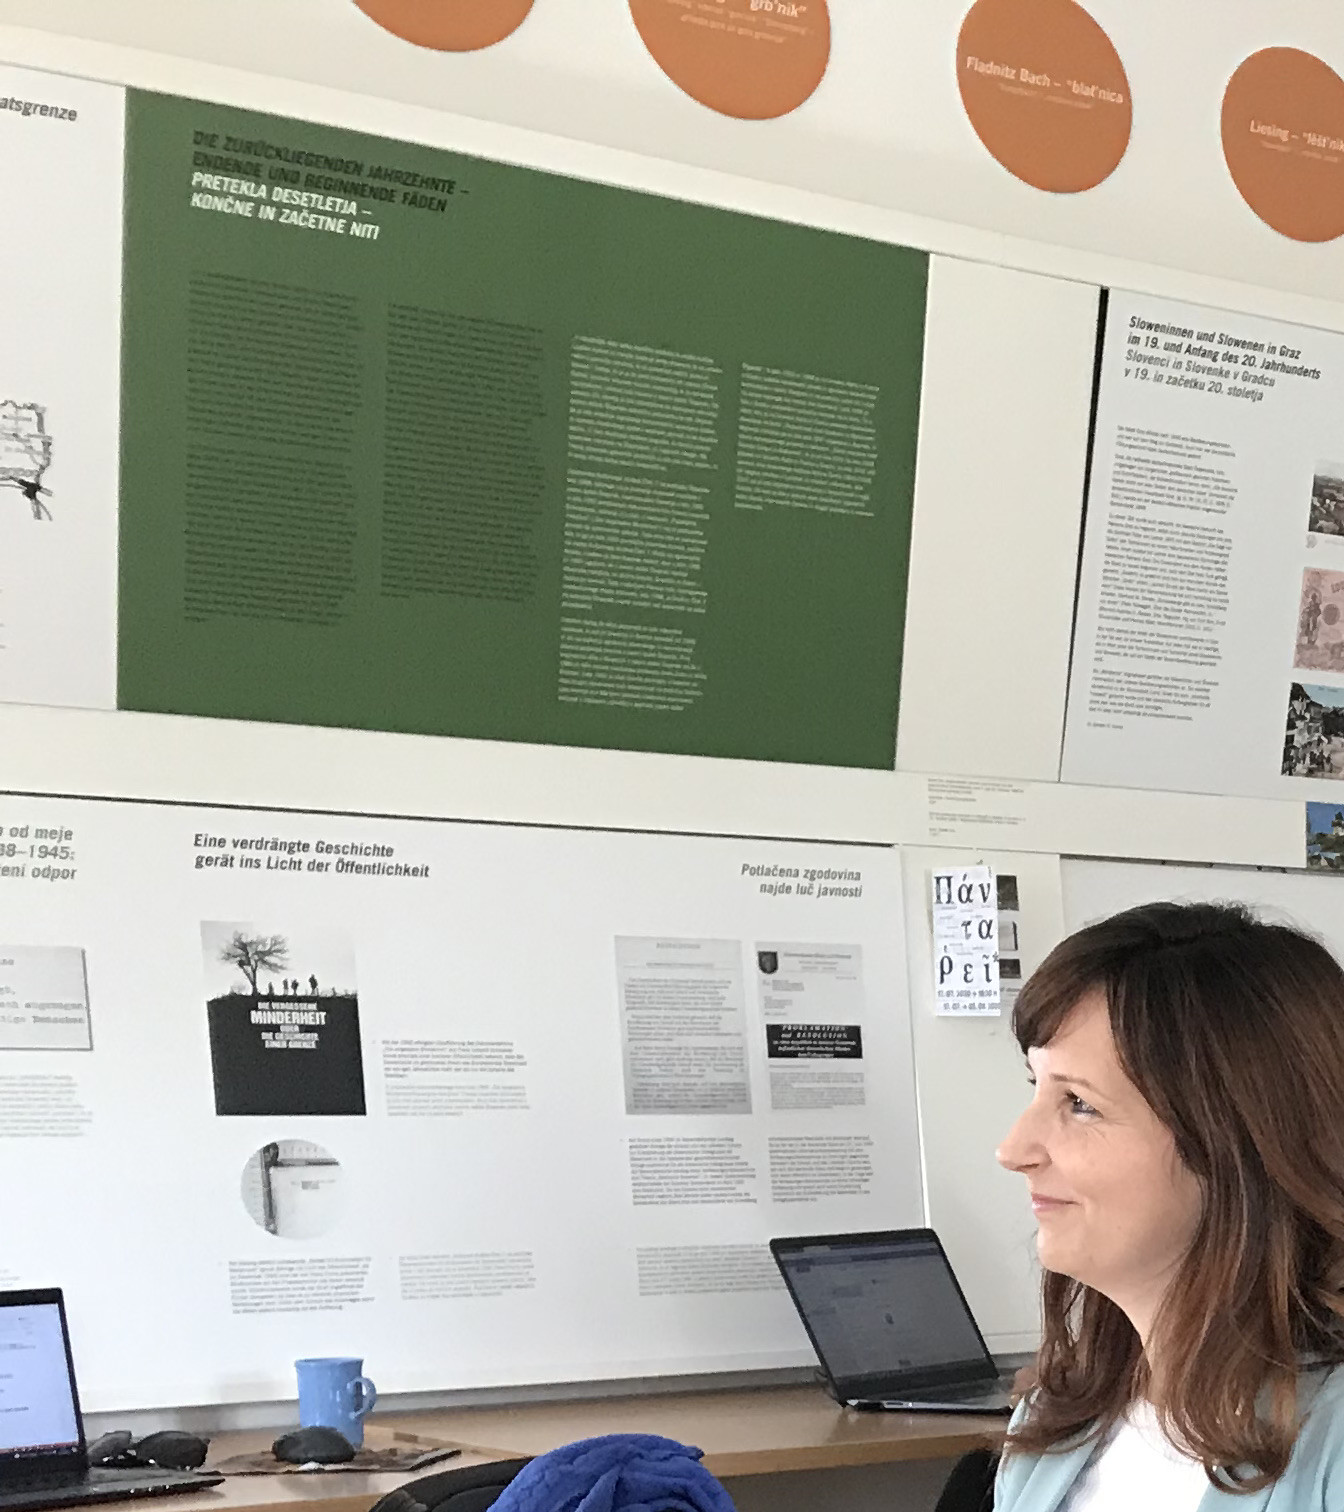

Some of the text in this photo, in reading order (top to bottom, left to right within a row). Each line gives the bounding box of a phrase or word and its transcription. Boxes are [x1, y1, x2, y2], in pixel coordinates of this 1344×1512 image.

[966, 56, 1050, 87] Fladnitz Bach
[193, 152, 262, 178] ENDENDE
[269, 165, 299, 184] UND
[304, 173, 396, 203] BEGINNENDE
[194, 130, 216, 146] DIE
[367, 165, 457, 195] JAHRZEHNTE
[192, 172, 357, 216] PRETEKLA DESETLETJA
[191, 192, 380, 240] KONČNE IN ZAČETNE NITI
[1129, 315, 1301, 360] Sloweninnen und Slowenen in Graz
[1125, 349, 1276, 387] Slovenci in Slovenke v Gradcu
[1127, 332, 1321, 380] im 19. und Anfang des 20. Jahrhunderts
[1124, 367, 1264, 402] v 19. in začetku 20. stoletja
[9, 825, 73, 843] od meje
[193, 833, 394, 858] Eine verdrängte Geschichte
[32, 865, 77, 881] odpor
[195, 854, 430, 878] gerät ins Licht der Öffentlichkeit
[741, 863, 862, 881] Potlačena zgodovina
[760, 882, 862, 898] najde luč javnosti
[250, 1010, 326, 1025] MINDERHEIT
